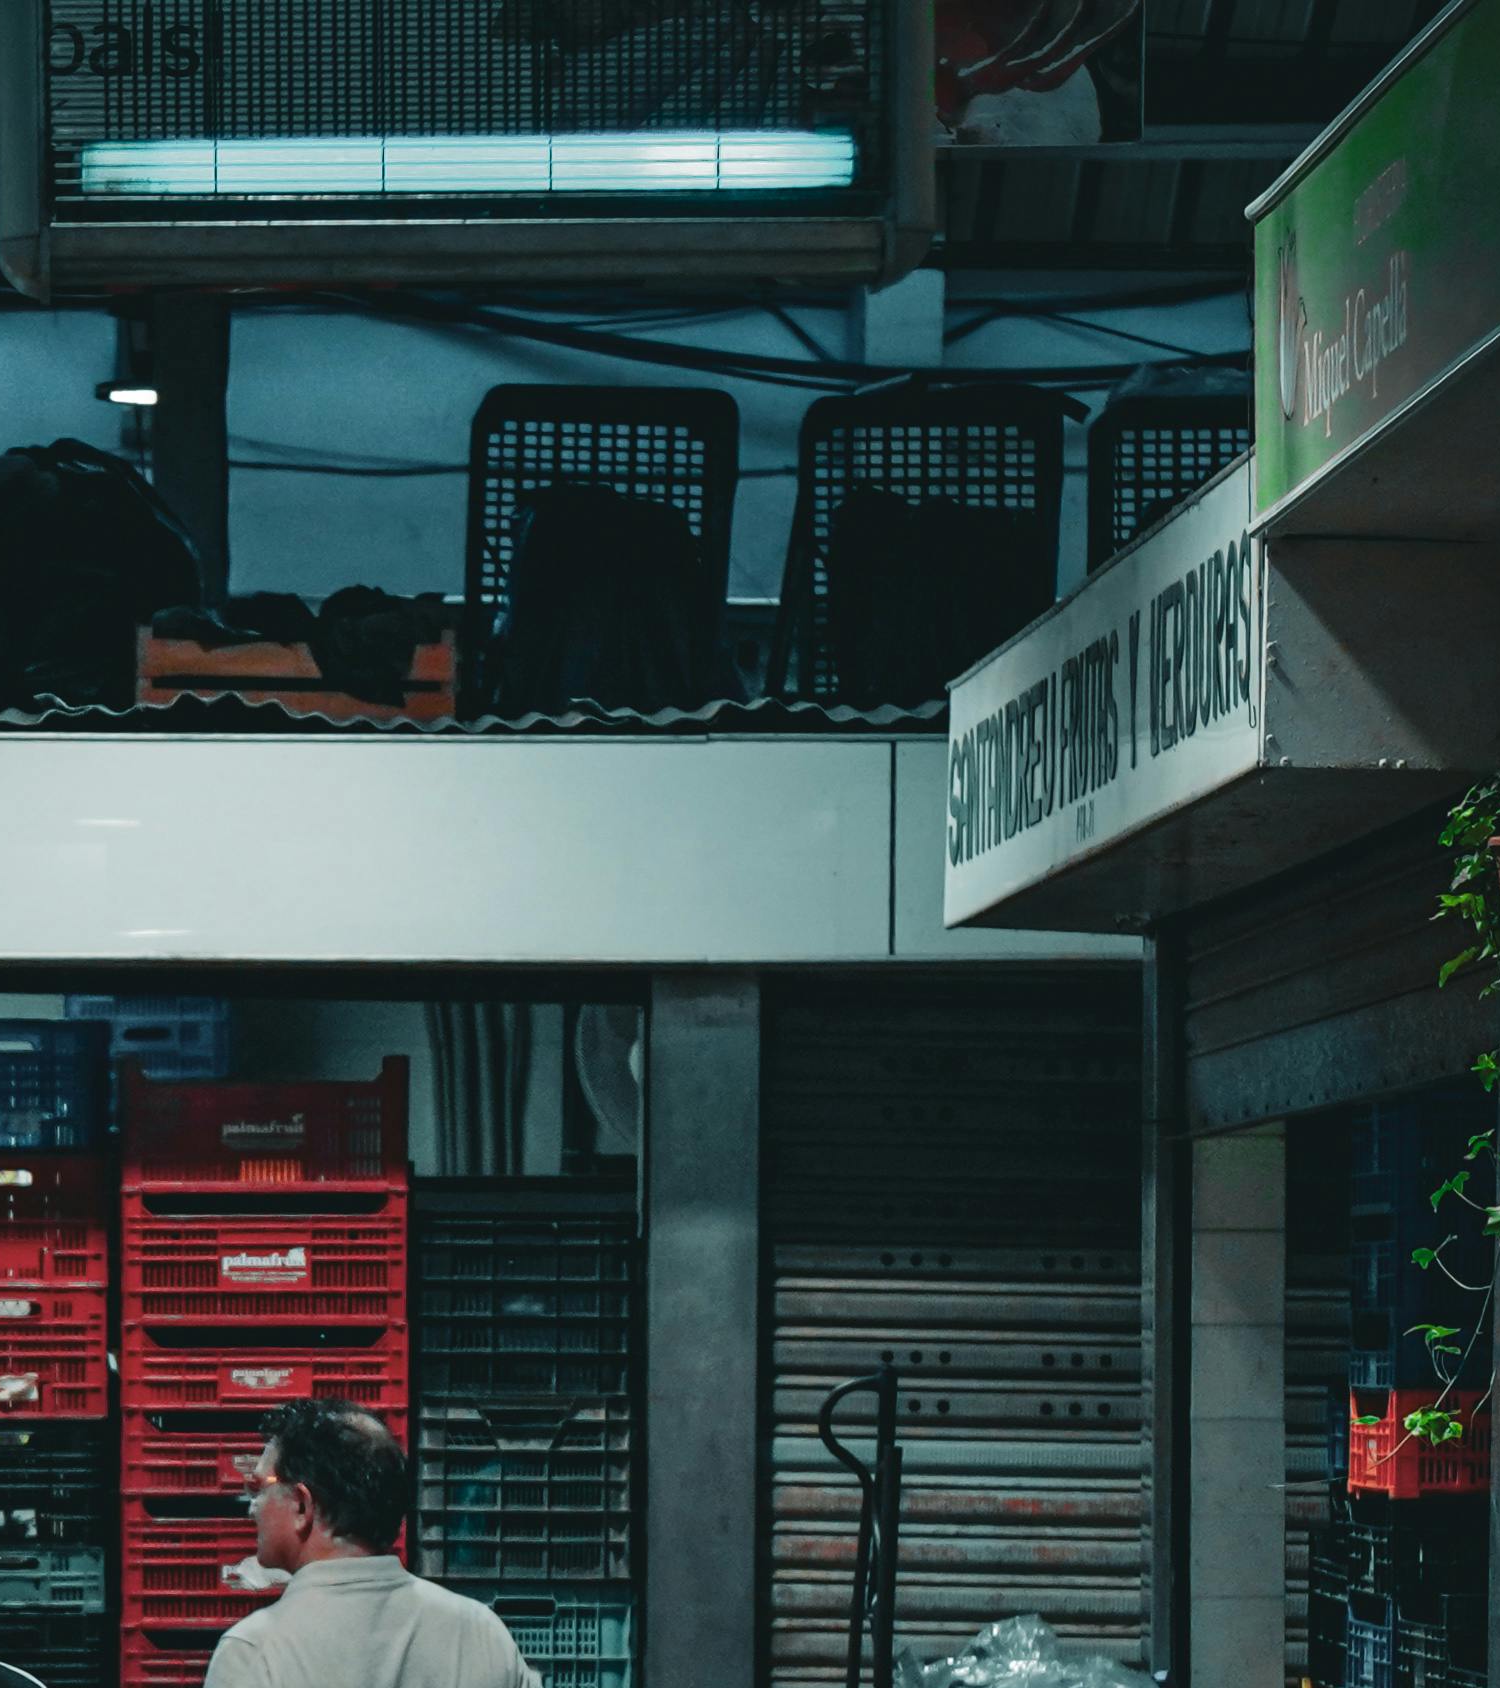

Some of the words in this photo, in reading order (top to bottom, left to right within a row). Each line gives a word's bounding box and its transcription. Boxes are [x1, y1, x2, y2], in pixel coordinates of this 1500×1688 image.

[1303, 298, 1350, 437] Miquel
[950, 671, 1057, 867] SANTANDREU
[1060, 629, 1119, 809] FRUTAS
[1129, 609, 1140, 769] Y
[1150, 529, 1251, 758] VERDURAS
